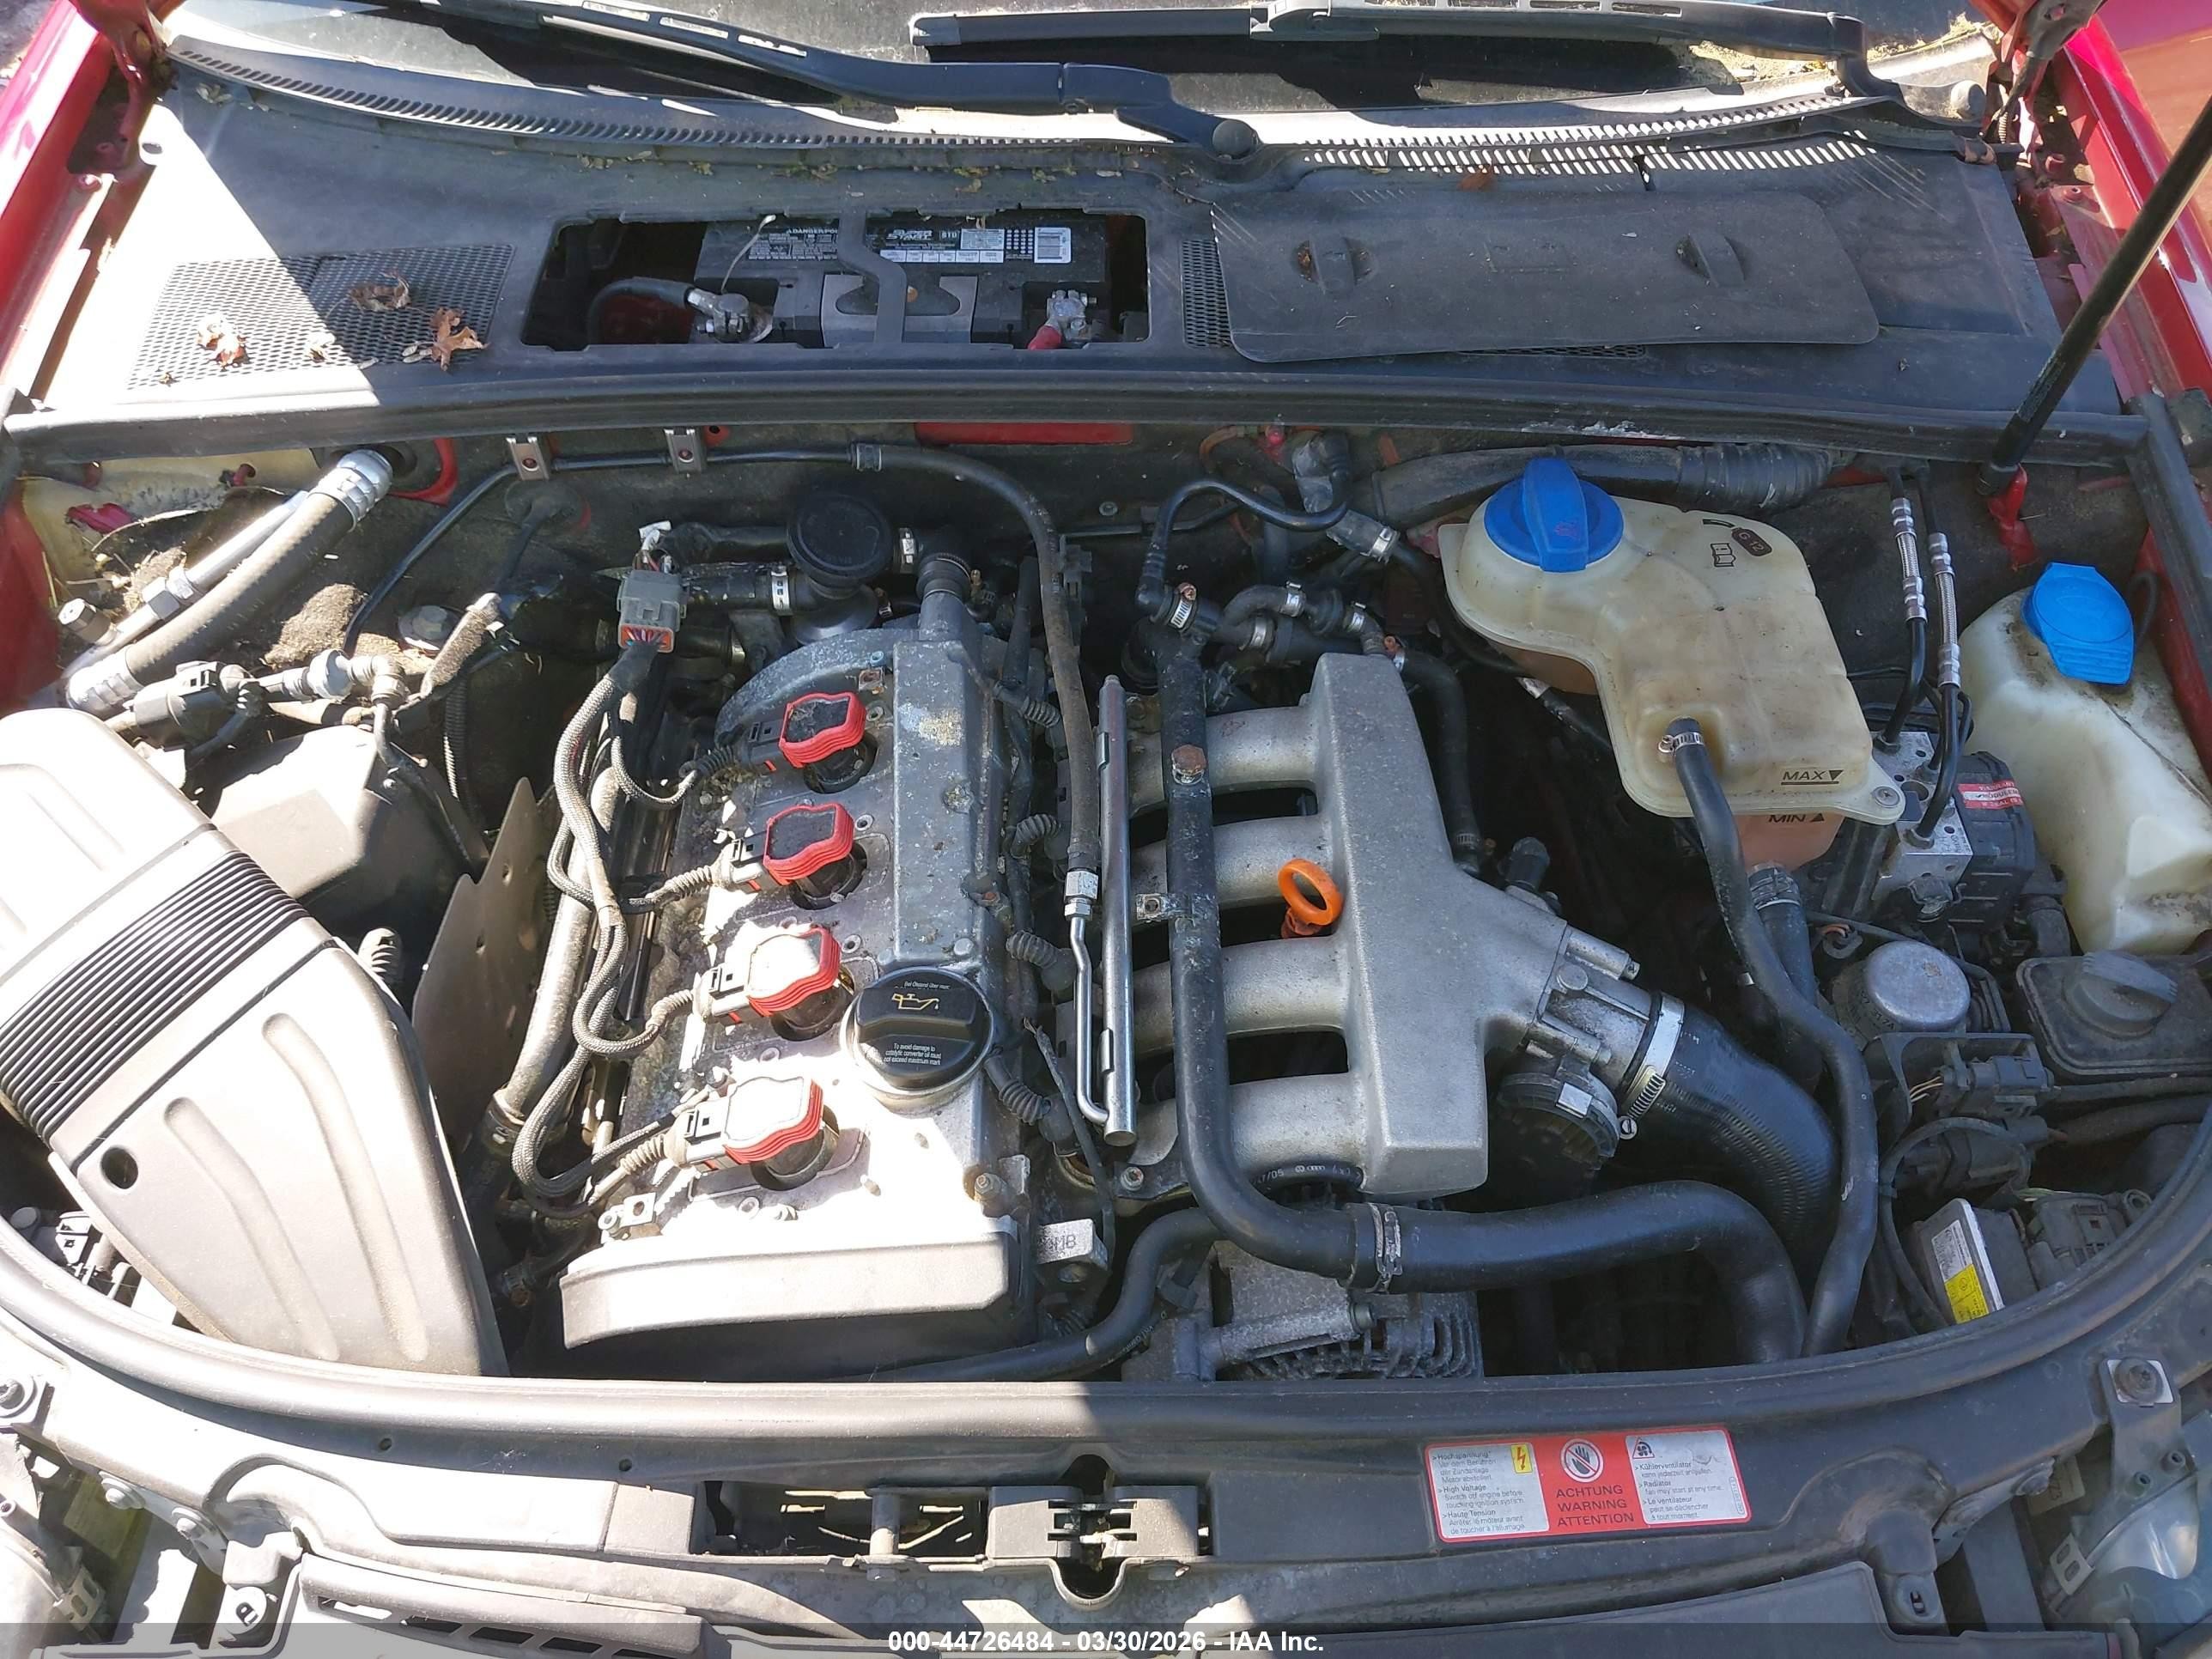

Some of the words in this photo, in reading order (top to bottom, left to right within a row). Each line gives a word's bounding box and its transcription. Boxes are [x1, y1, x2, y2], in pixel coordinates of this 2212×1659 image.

[1783, 770, 1826, 781] MAX
[1769, 813, 1806, 823] MIN
[1444, 1492, 1468, 1501] Switch
[1556, 1485, 1623, 1498] ACHTUNG
[1558, 1498, 1627, 1512] WARNING
[1657, 1496, 1692, 1504] ventilateur
[1558, 1512, 1634, 1527] ATTENTION
